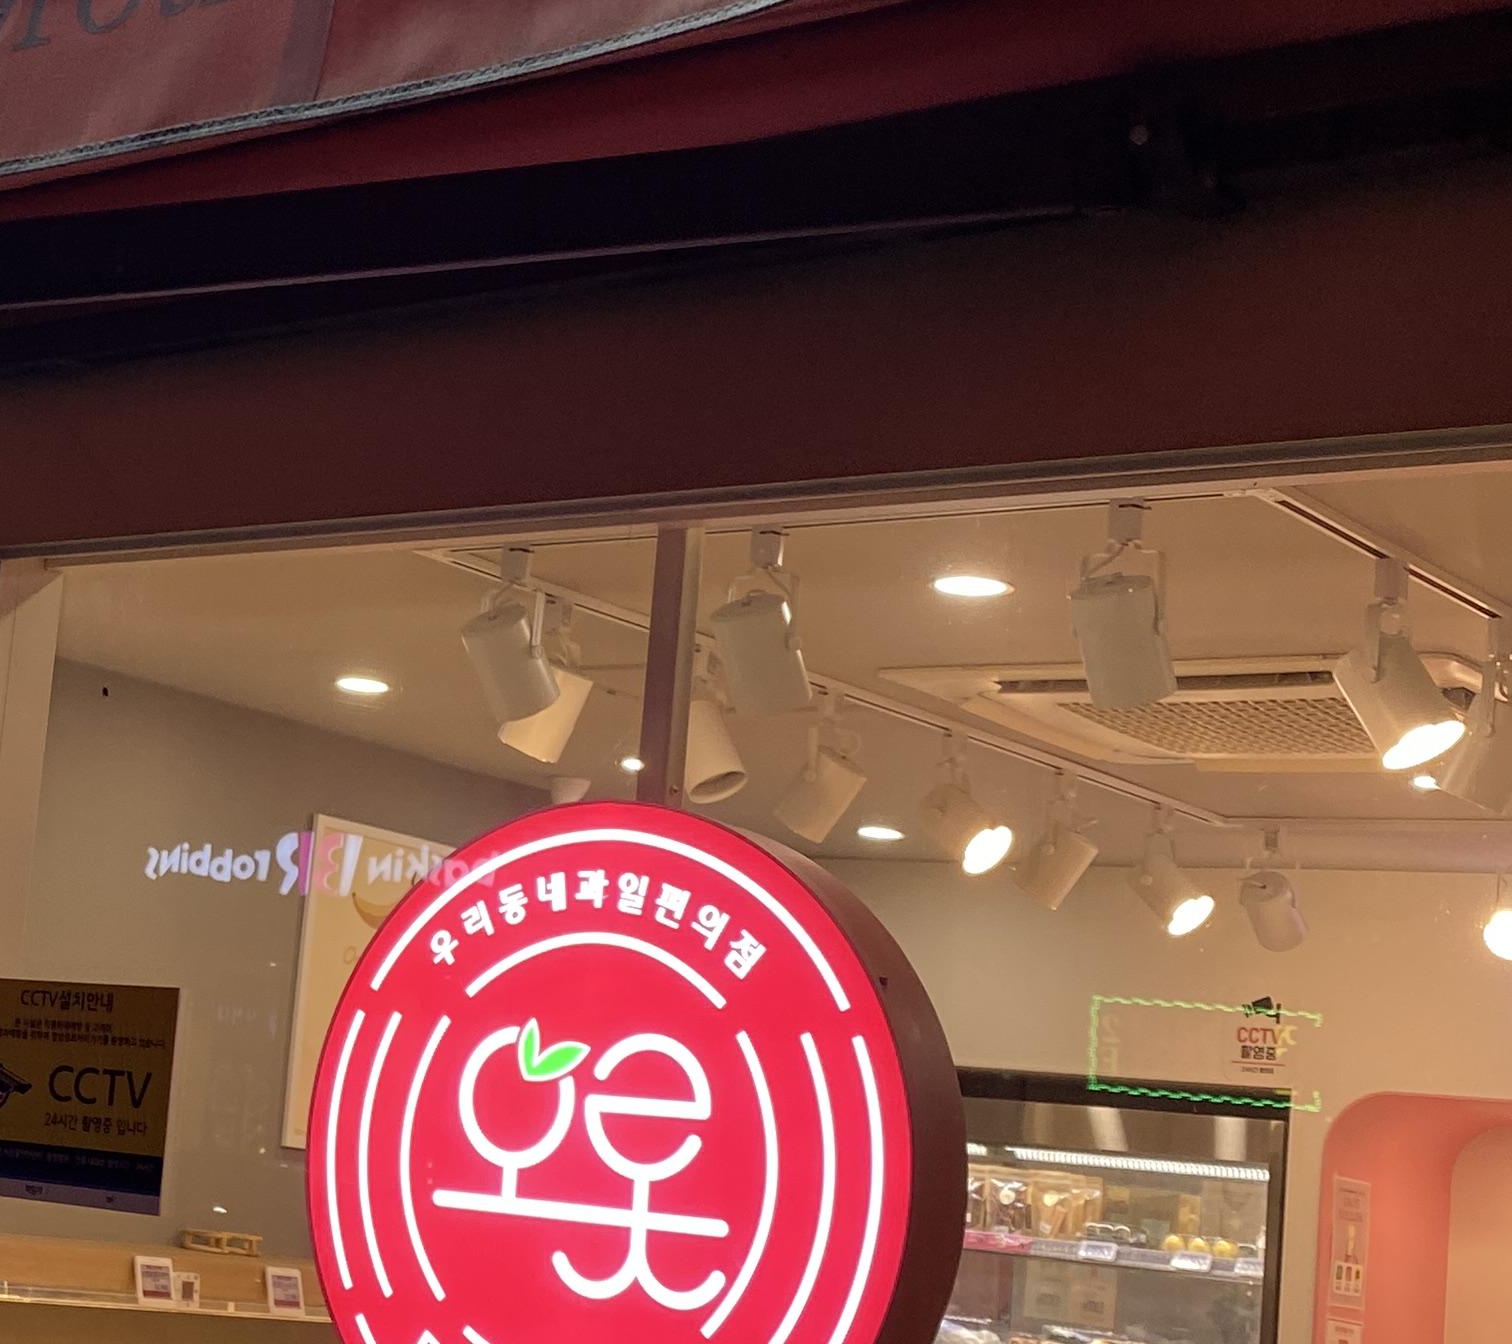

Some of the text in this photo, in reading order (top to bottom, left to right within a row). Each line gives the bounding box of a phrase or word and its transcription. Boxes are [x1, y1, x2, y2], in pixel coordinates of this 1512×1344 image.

[47, 1064, 153, 1110] CCTV
[43, 1112, 149, 1136] 24시간 촬영중 입니다
